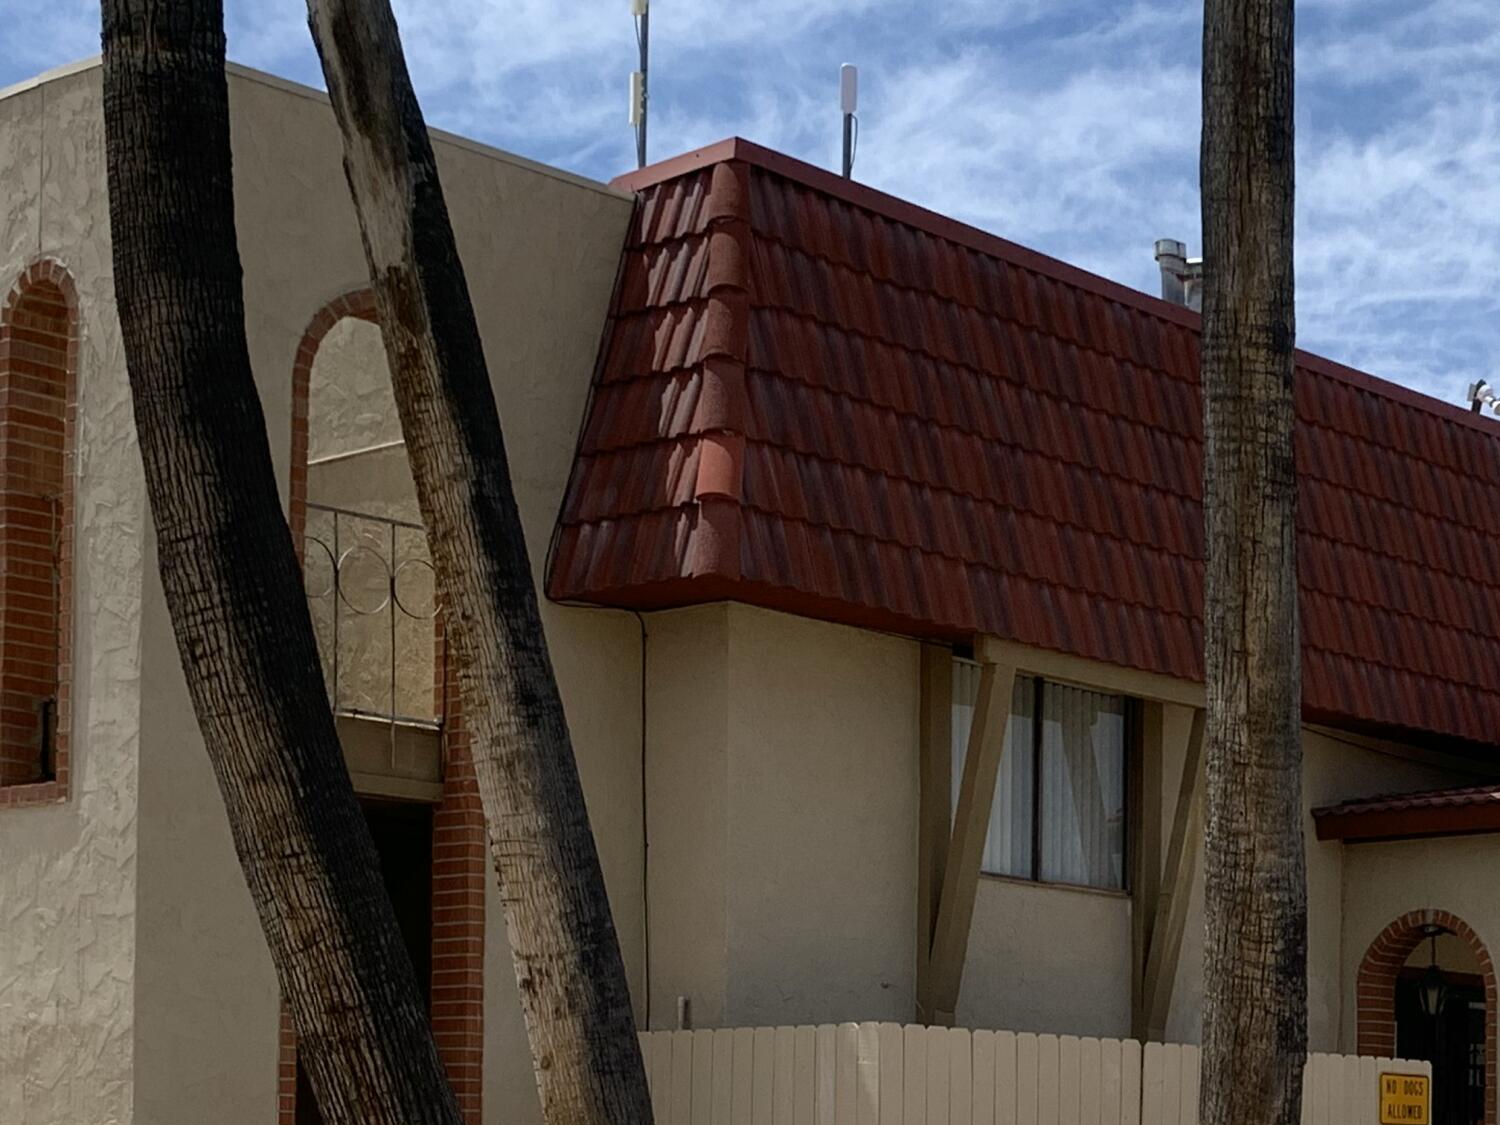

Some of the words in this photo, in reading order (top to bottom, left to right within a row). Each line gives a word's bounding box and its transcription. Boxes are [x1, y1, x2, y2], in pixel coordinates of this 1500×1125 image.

[1386, 1079, 1397, 1095] NO
[1404, 1080, 1424, 1096] DOGS
[1387, 1103, 1423, 1120] ALLOWED
